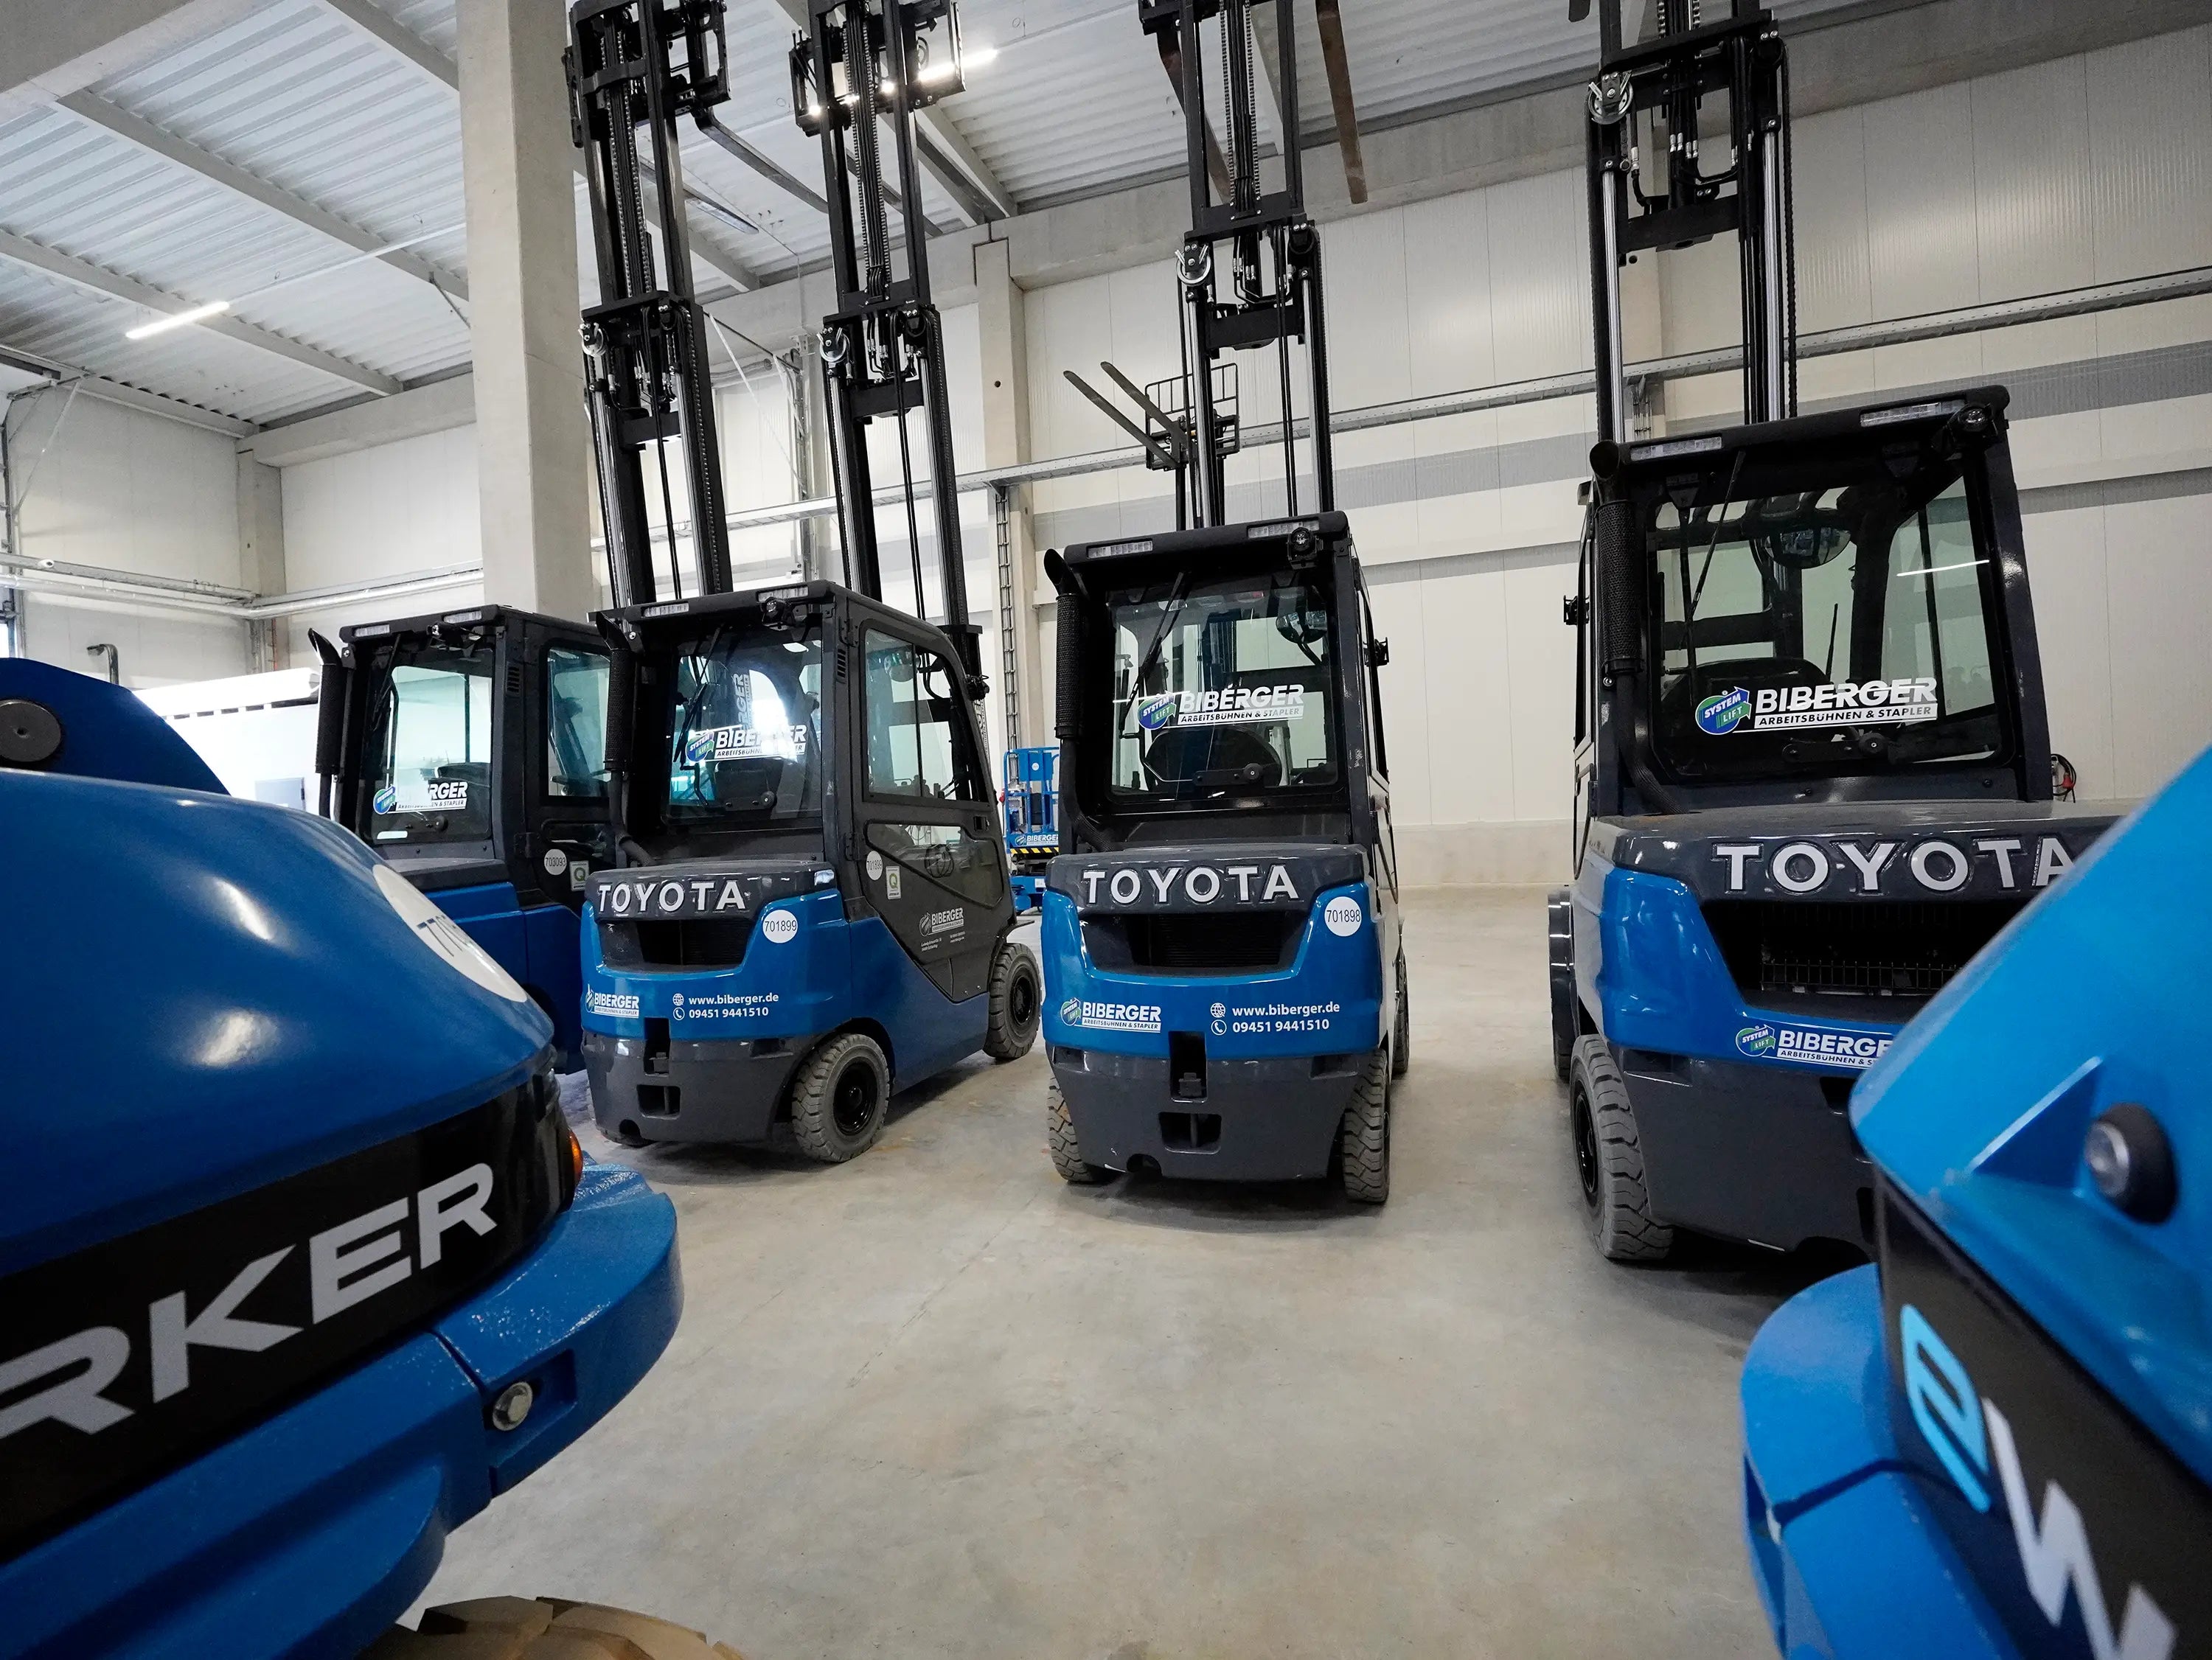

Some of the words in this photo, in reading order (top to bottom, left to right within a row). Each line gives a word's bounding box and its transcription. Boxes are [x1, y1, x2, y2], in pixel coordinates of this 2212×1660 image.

[1180, 684, 1304, 713] BIBERGER
[1756, 677, 1938, 713] BIBERGER
[1143, 696, 1170, 716] SYSTEM
[1155, 705, 1170, 720] LIFT
[1704, 693, 1741, 719] SYSTEM
[1722, 705, 1743, 723] LIFT
[1181, 711, 1252, 722] ARBEITSBÜHNEN
[1263, 708, 1299, 717] STAPLER
[1759, 711, 1862, 726] ARBEITSBÜHNEN
[1866, 710, 1874, 718] &
[1878, 706, 1931, 718] STAPLER
[1717, 837, 2076, 891] TOYOTA
[1083, 865, 1299, 904] TOYOTA
[599, 880, 746, 913] TOYOTA
[932, 907, 964, 925] BIBERGER
[1326, 910, 1361, 923] 701898
[764, 920, 797, 932] 701899
[594, 992, 640, 1009] BIBERGER
[689, 992, 779, 1005] www.biberger.de
[689, 1008, 719, 1019] 09451
[723, 1007, 769, 1018] 9441510
[1082, 1002, 1161, 1022] BIBERGER
[1232, 1001, 1340, 1016] www.biberger.de
[1232, 1022, 1271, 1033] 09451
[1275, 1019, 1329, 1031] 9441510
[1742, 1029, 1769, 1044] SYSTEM
[1755, 1039, 1770, 1050] LIFT
[1778, 1030, 1893, 1057] BIBERGE
[1780, 1050, 1855, 1064] ARBEITSBÜHNEN
